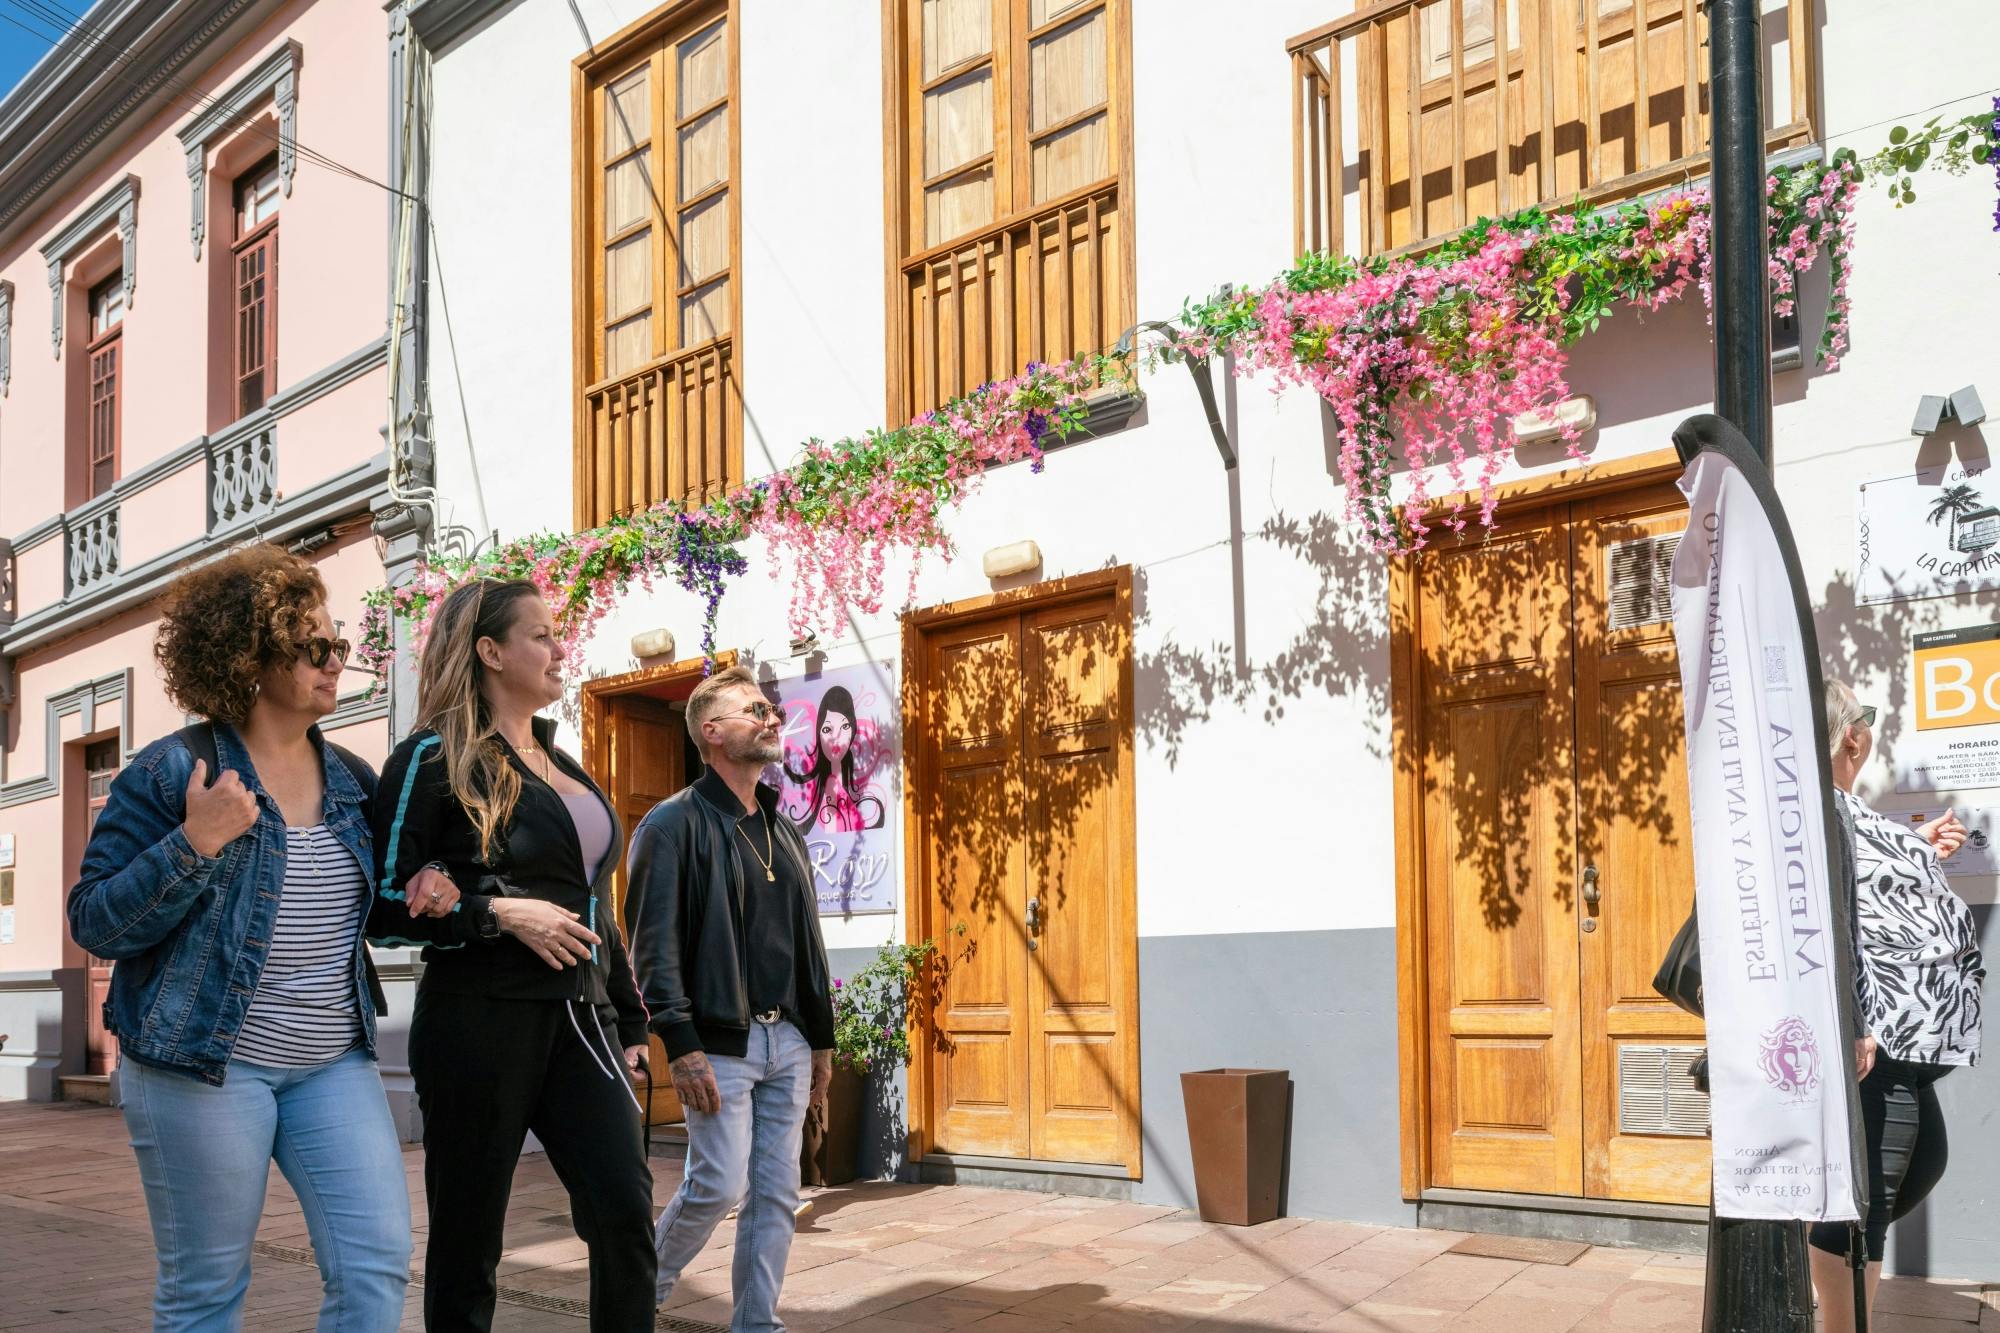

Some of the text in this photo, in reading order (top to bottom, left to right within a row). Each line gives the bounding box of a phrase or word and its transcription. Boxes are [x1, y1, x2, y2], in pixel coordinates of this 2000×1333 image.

[1951, 468, 1983, 481] CASA
[1916, 552, 1938, 572] LA
[1948, 739, 1999, 750] HORARIO
